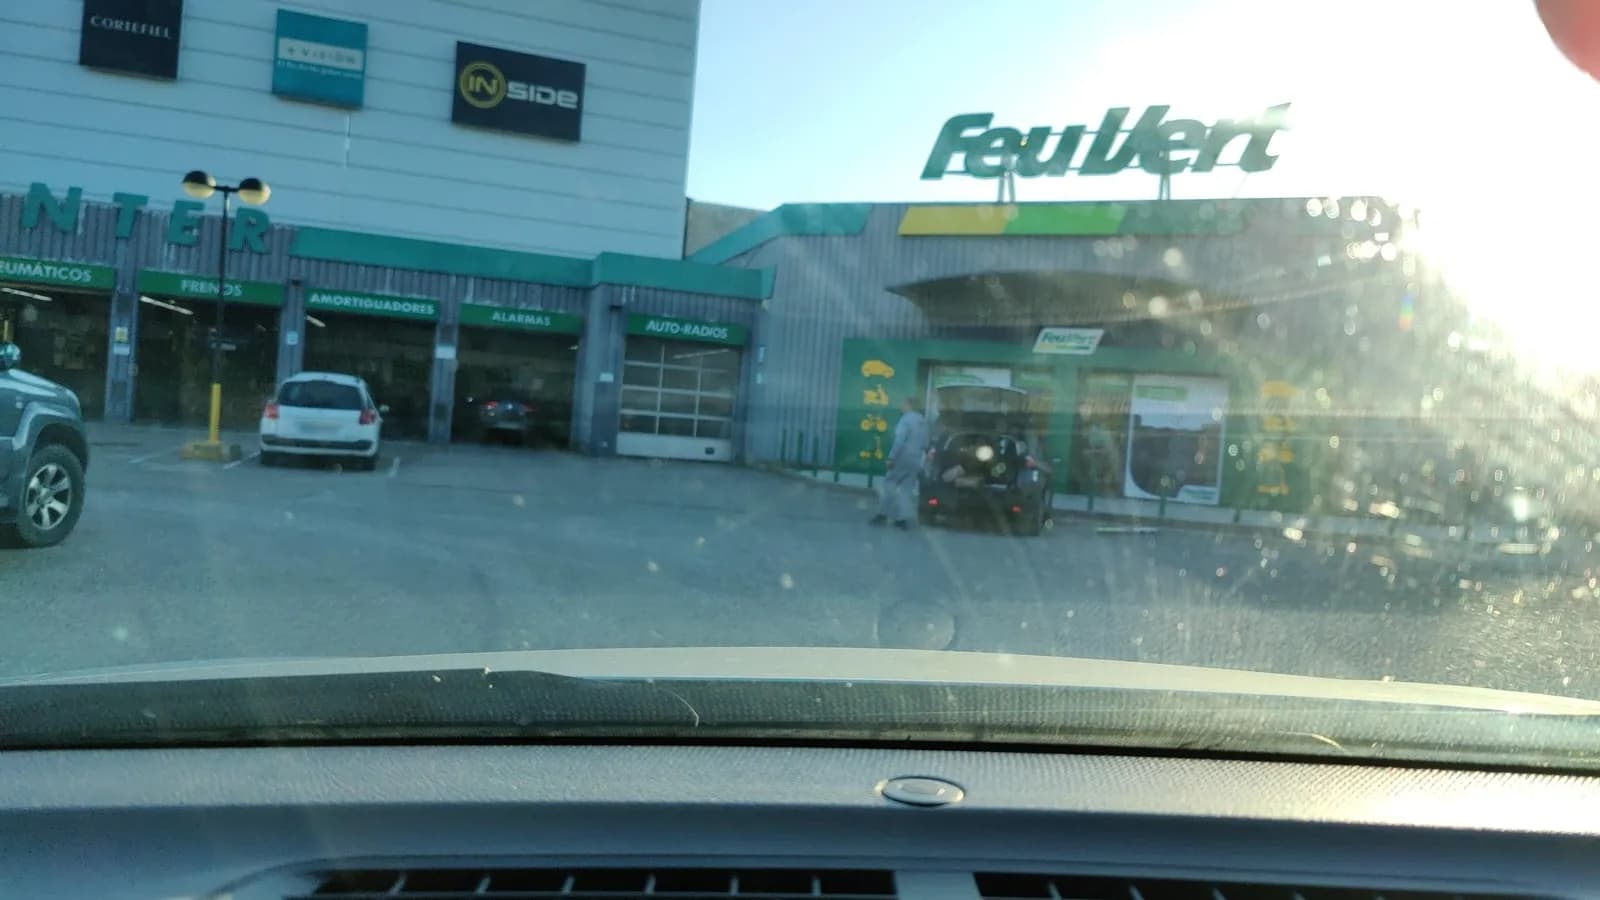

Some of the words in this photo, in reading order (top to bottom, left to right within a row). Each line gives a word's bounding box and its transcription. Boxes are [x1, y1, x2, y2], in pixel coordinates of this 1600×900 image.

[90, 15, 170, 38] CORTEFIEL
[310, 293, 435, 315] AMORTIGUADORES
[492, 311, 551, 327] ALARMAS
[645, 319, 728, 339] AUTO-RADIOS
